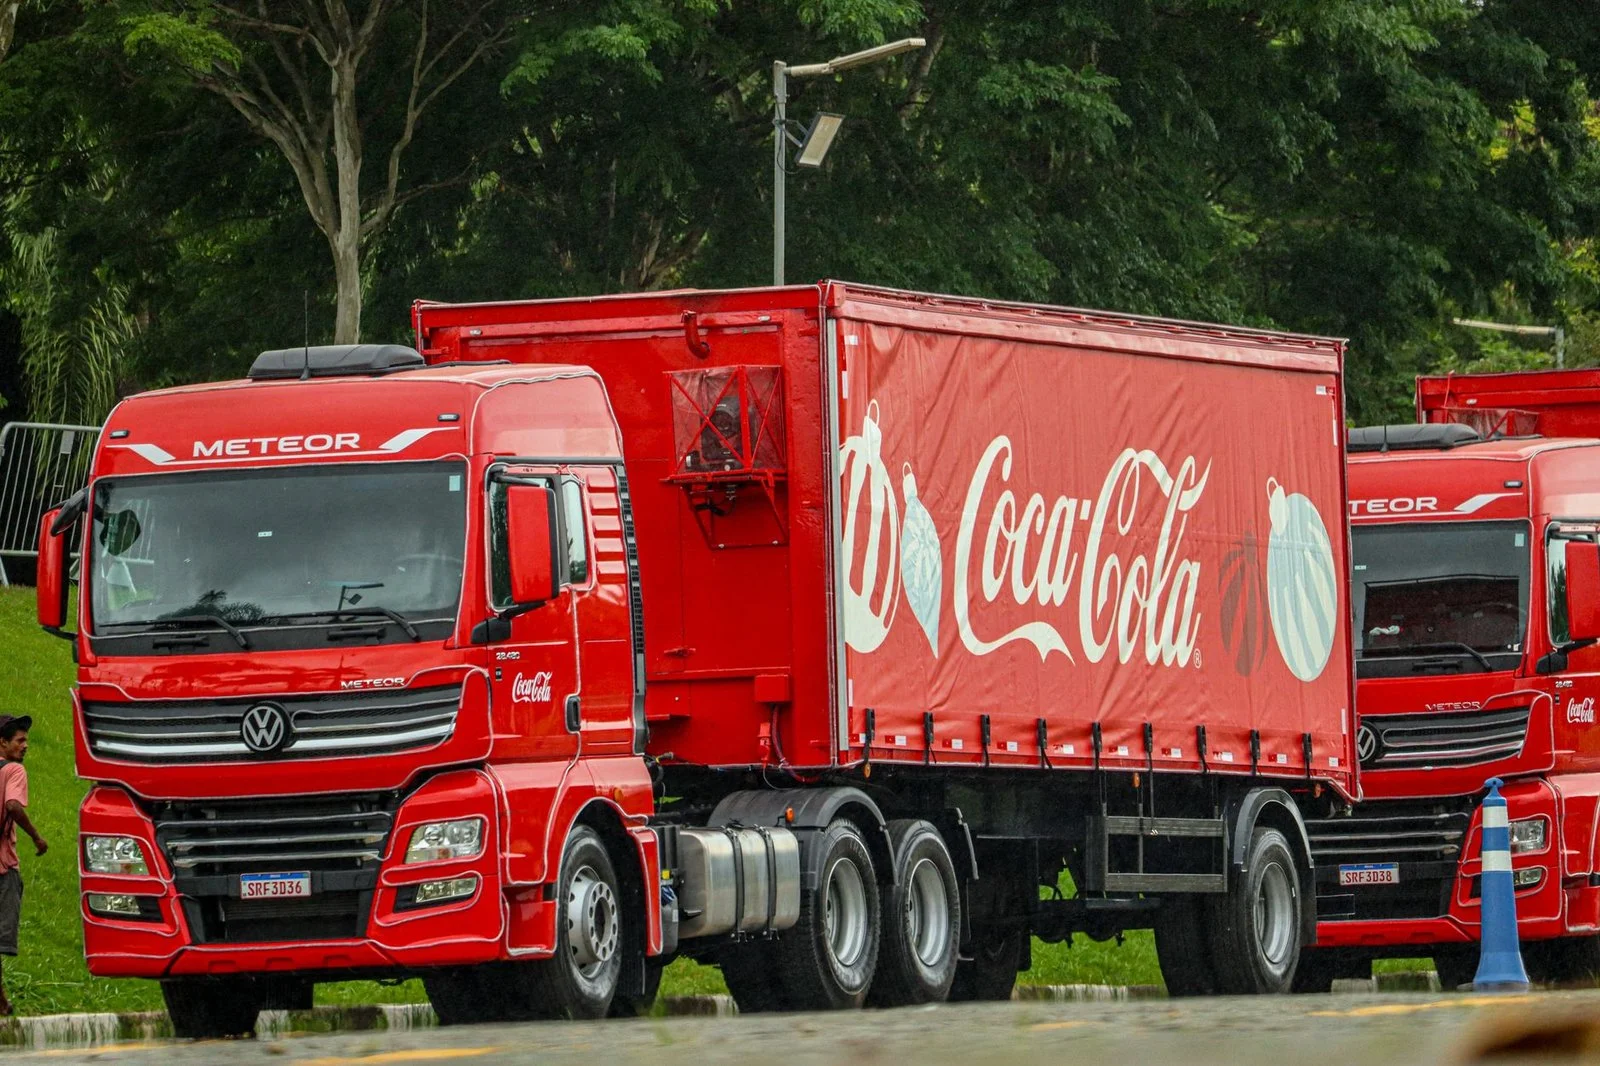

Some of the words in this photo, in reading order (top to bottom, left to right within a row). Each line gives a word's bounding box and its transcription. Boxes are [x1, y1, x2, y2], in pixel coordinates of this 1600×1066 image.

[192, 432, 361, 458] METEOR
[1348, 496, 1438, 514] TEOR
[953, 434, 1213, 669] Coca-Cola
[340, 677, 405, 689] METEOR
[511, 671, 553, 704] Coca-Cola
[1425, 701, 1481, 711] METEOR
[1566, 697, 1596, 724] Coca-Cola
[1345, 870, 1393, 884] SRF3D38
[247, 880, 303, 897] SRF3D36
